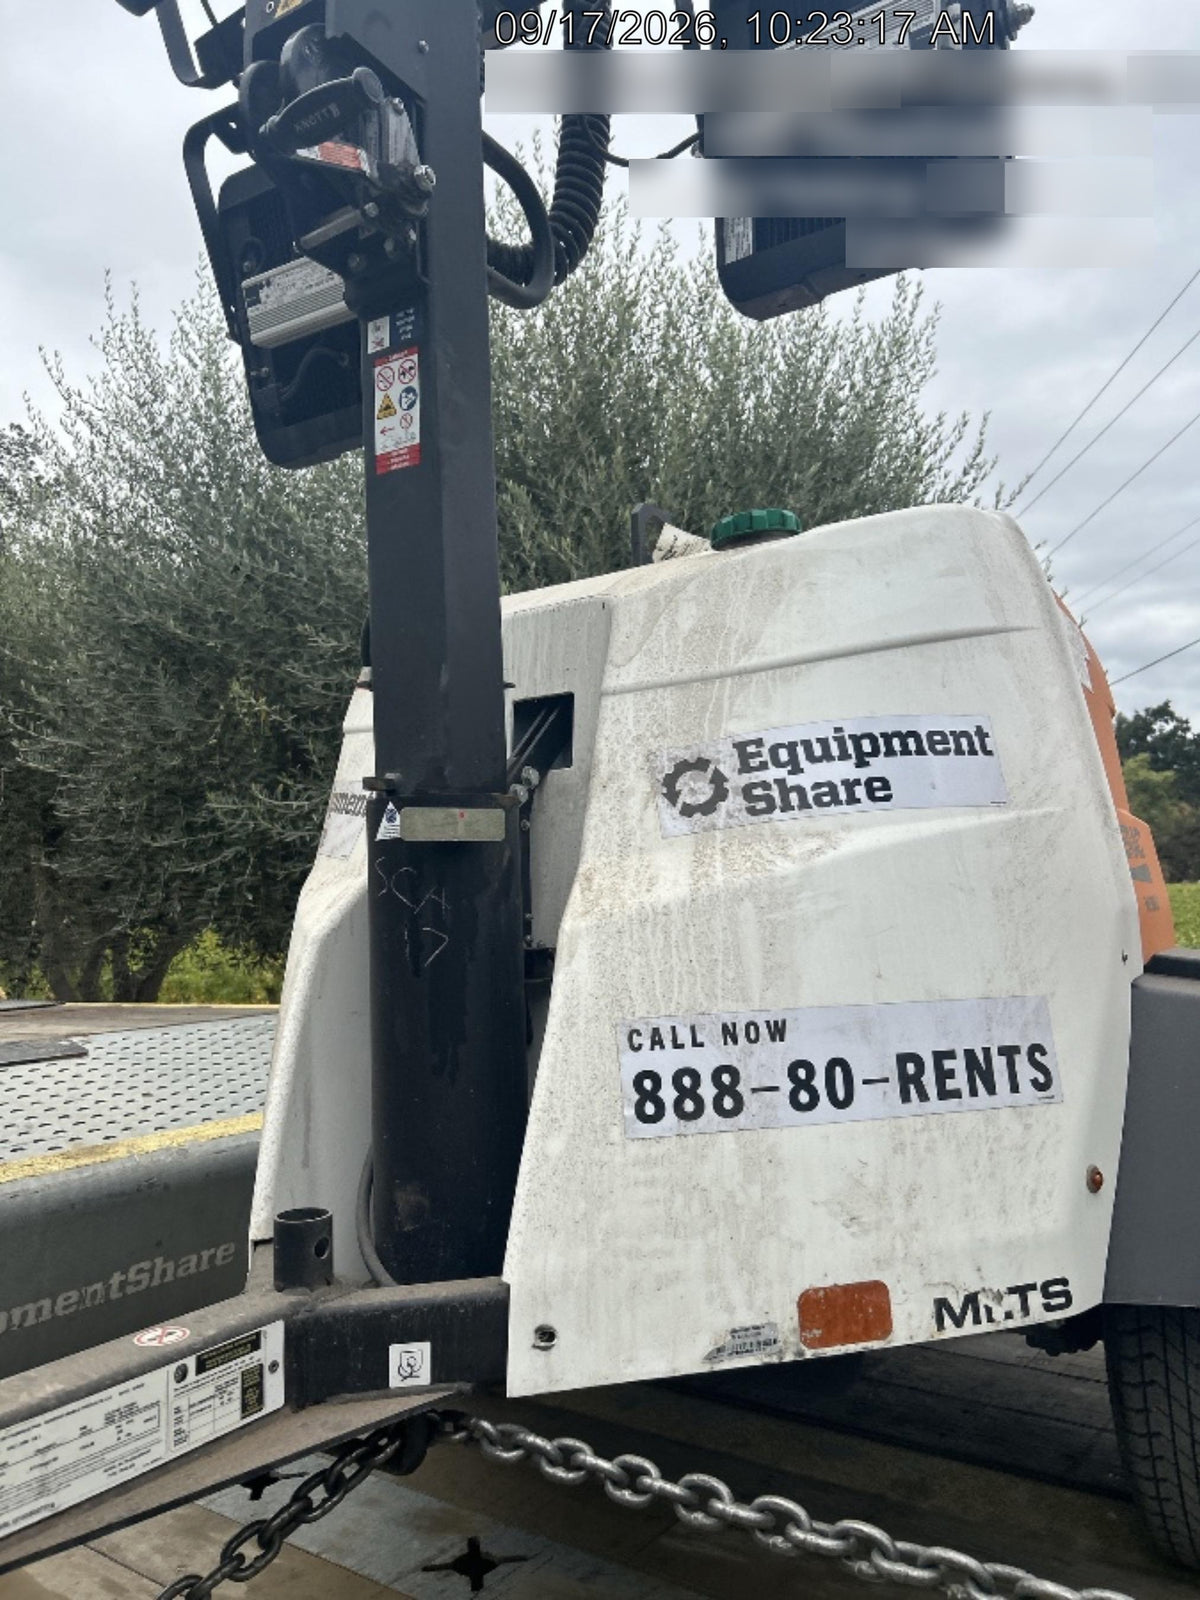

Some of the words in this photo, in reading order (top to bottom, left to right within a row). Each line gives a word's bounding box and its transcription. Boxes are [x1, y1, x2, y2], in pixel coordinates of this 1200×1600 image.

[732, 724, 993, 775] Equipment
[741, 774, 893, 817] Share
[627, 1024, 705, 1052] CALL
[721, 1018, 788, 1046] NOW
[632, 1042, 1054, 1124] 888-80-RENTS
